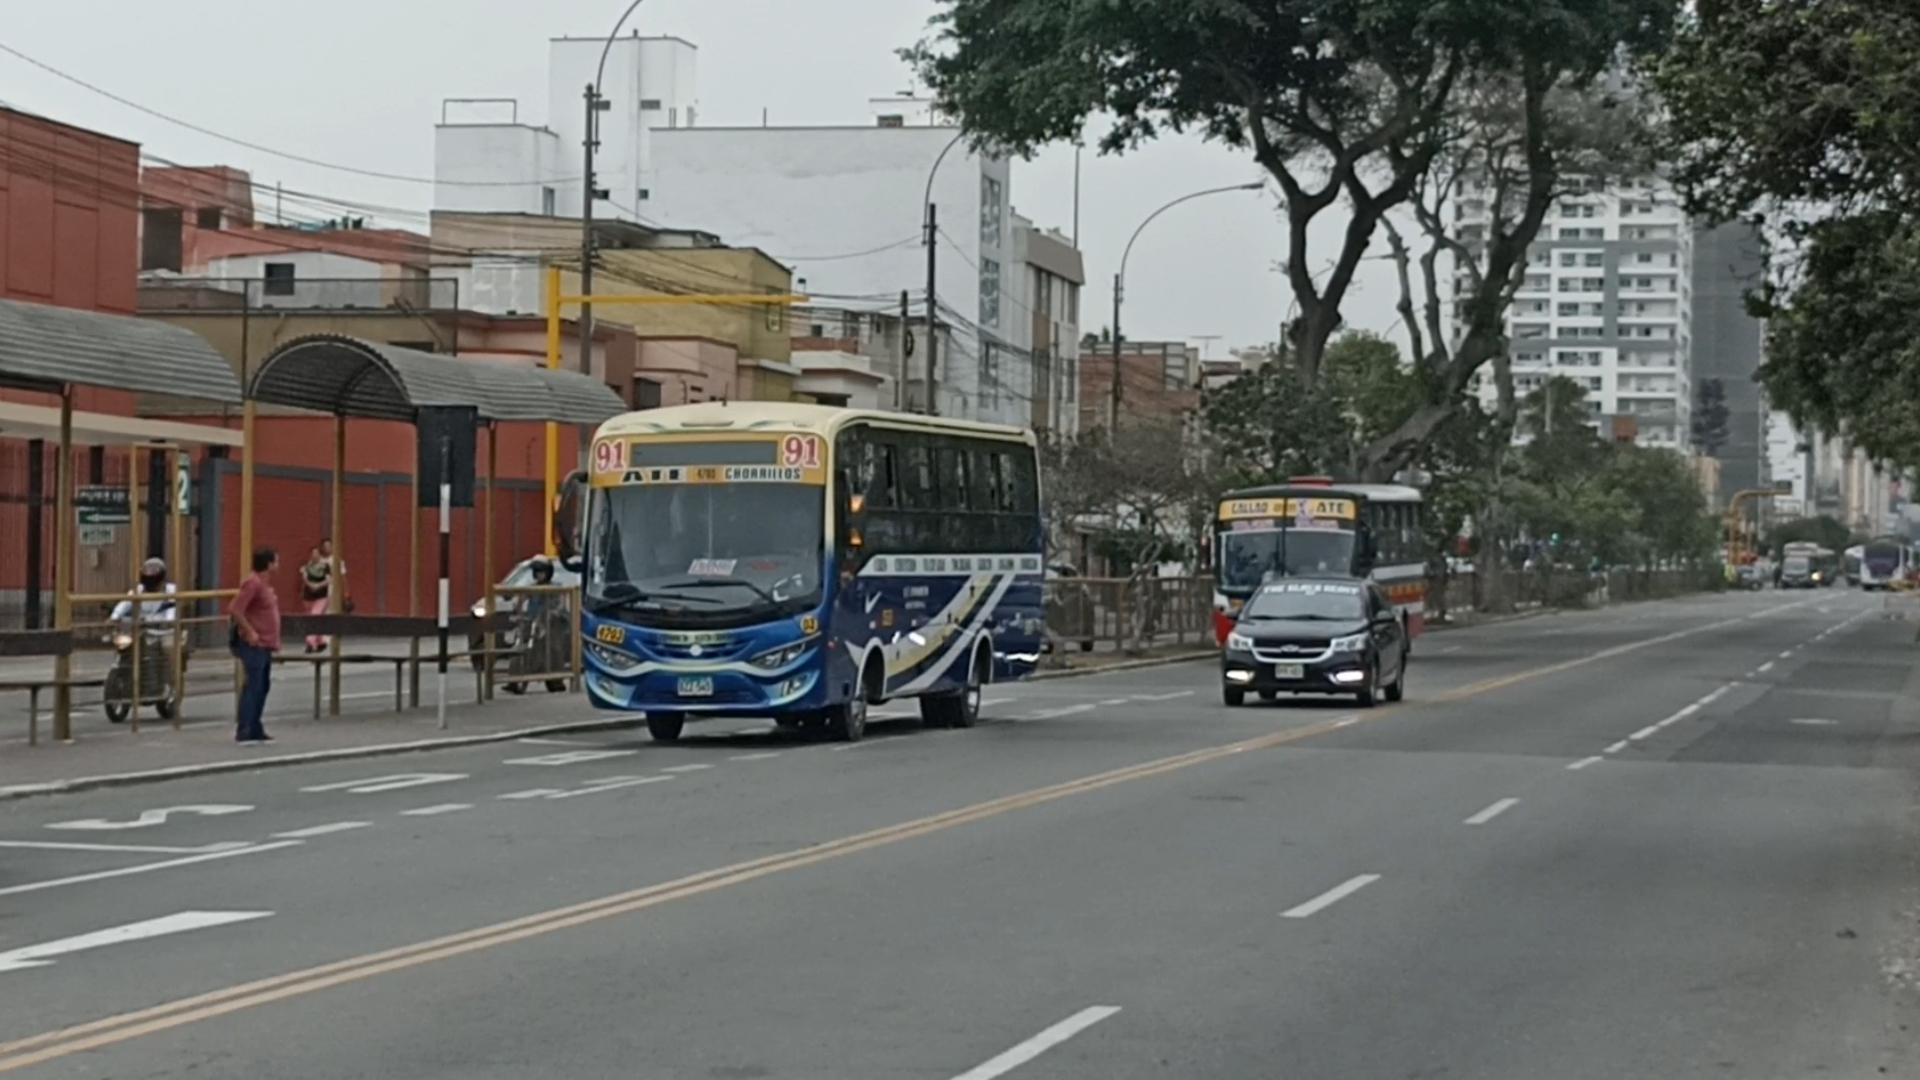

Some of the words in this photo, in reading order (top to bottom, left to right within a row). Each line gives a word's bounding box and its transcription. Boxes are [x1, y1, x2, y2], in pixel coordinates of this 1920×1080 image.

[596, 441, 626, 471] 91
[784, 436, 819, 466] 91
[725, 467, 801, 481] CHORRILLOS
[1231, 502, 1268, 515] CALLAO
[1316, 501, 1345, 513] ATE
